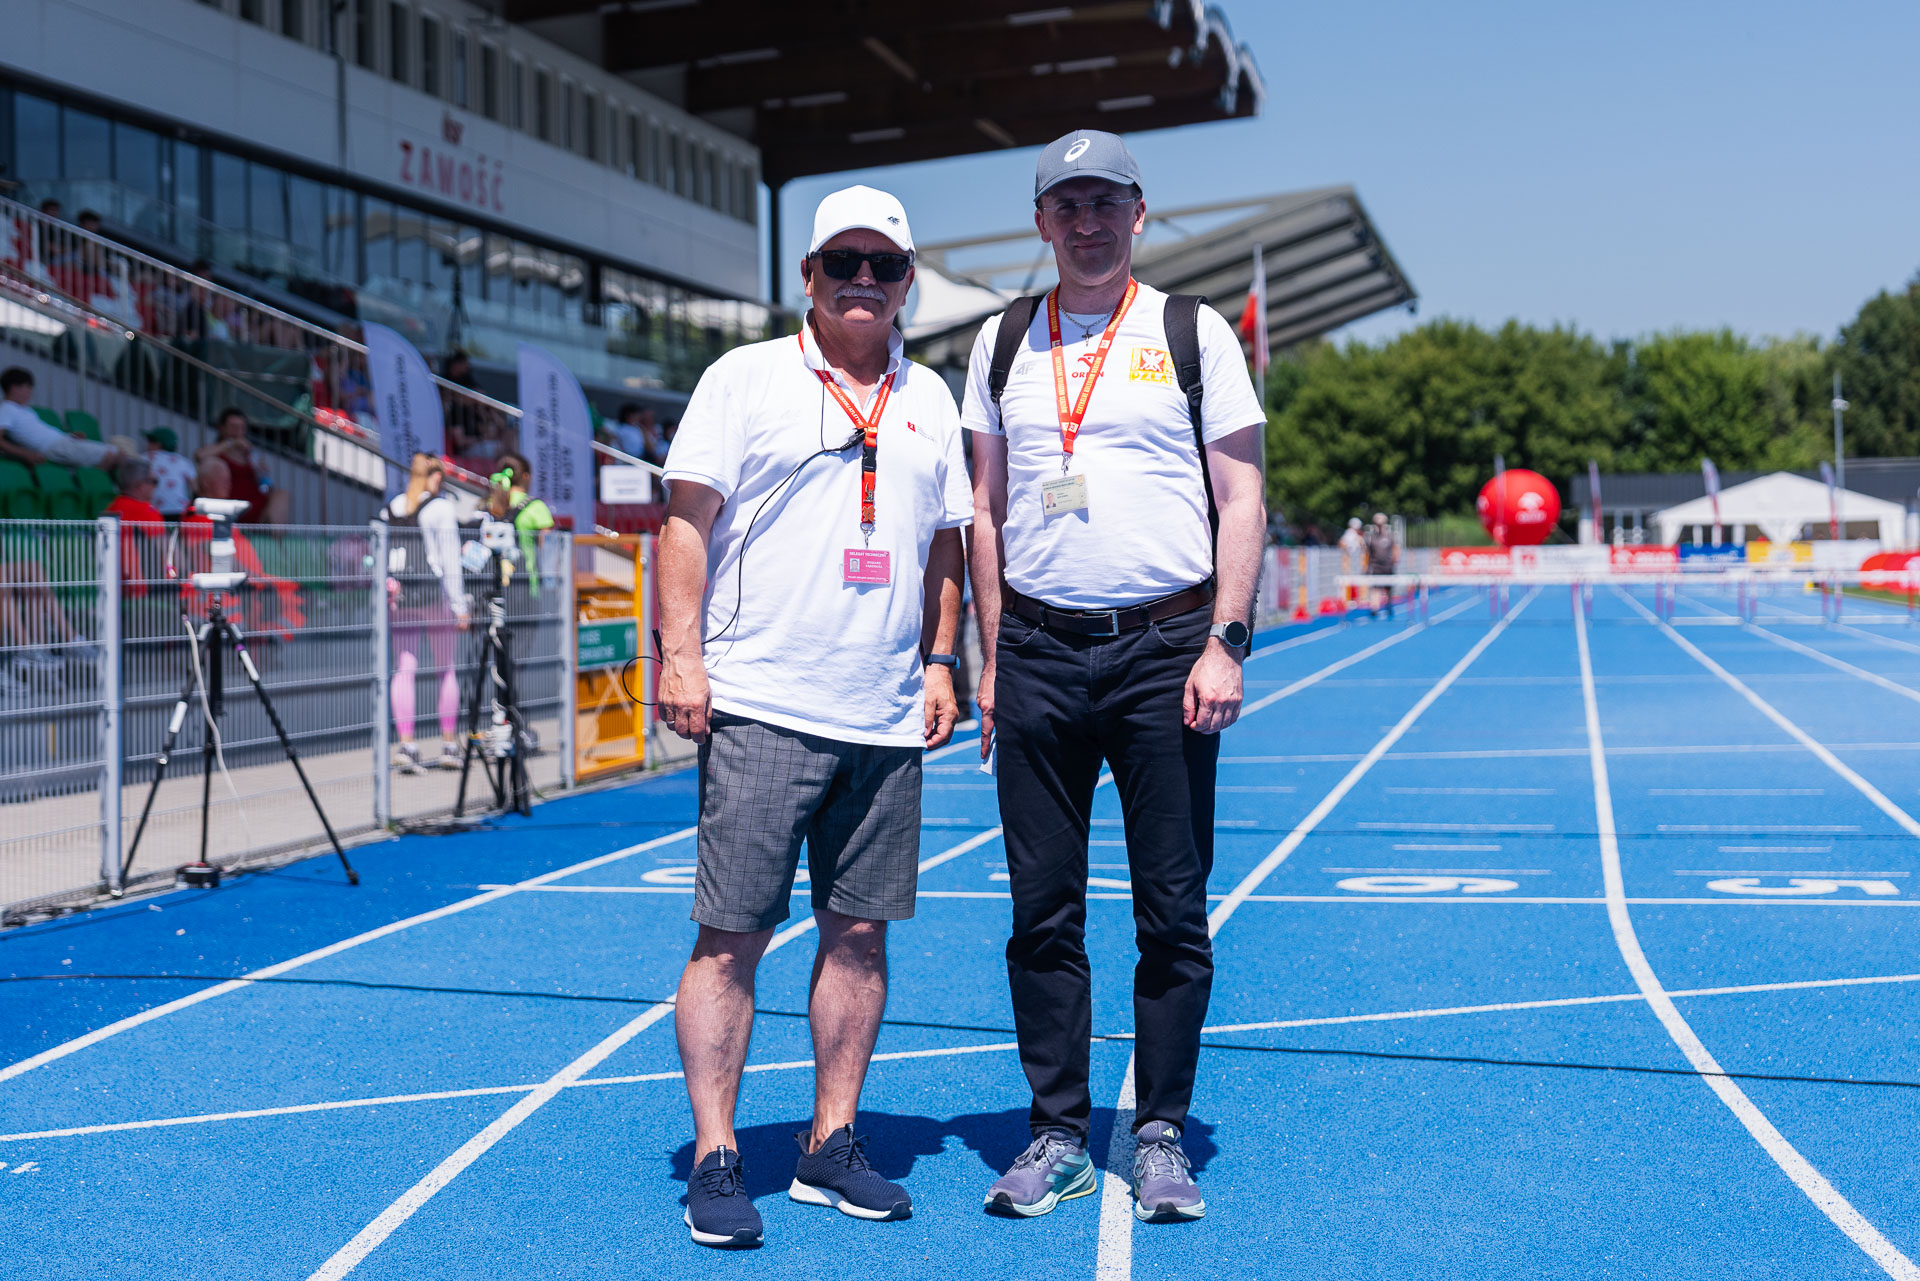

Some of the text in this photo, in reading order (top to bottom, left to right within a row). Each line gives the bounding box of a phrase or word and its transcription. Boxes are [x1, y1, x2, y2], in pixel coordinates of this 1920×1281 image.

[400, 139, 505, 214] ZAMOŚĆ
[1071, 371, 1105, 379] ORN
[1131, 372, 1169, 384] PZLA
[1706, 877, 1902, 896] 5
